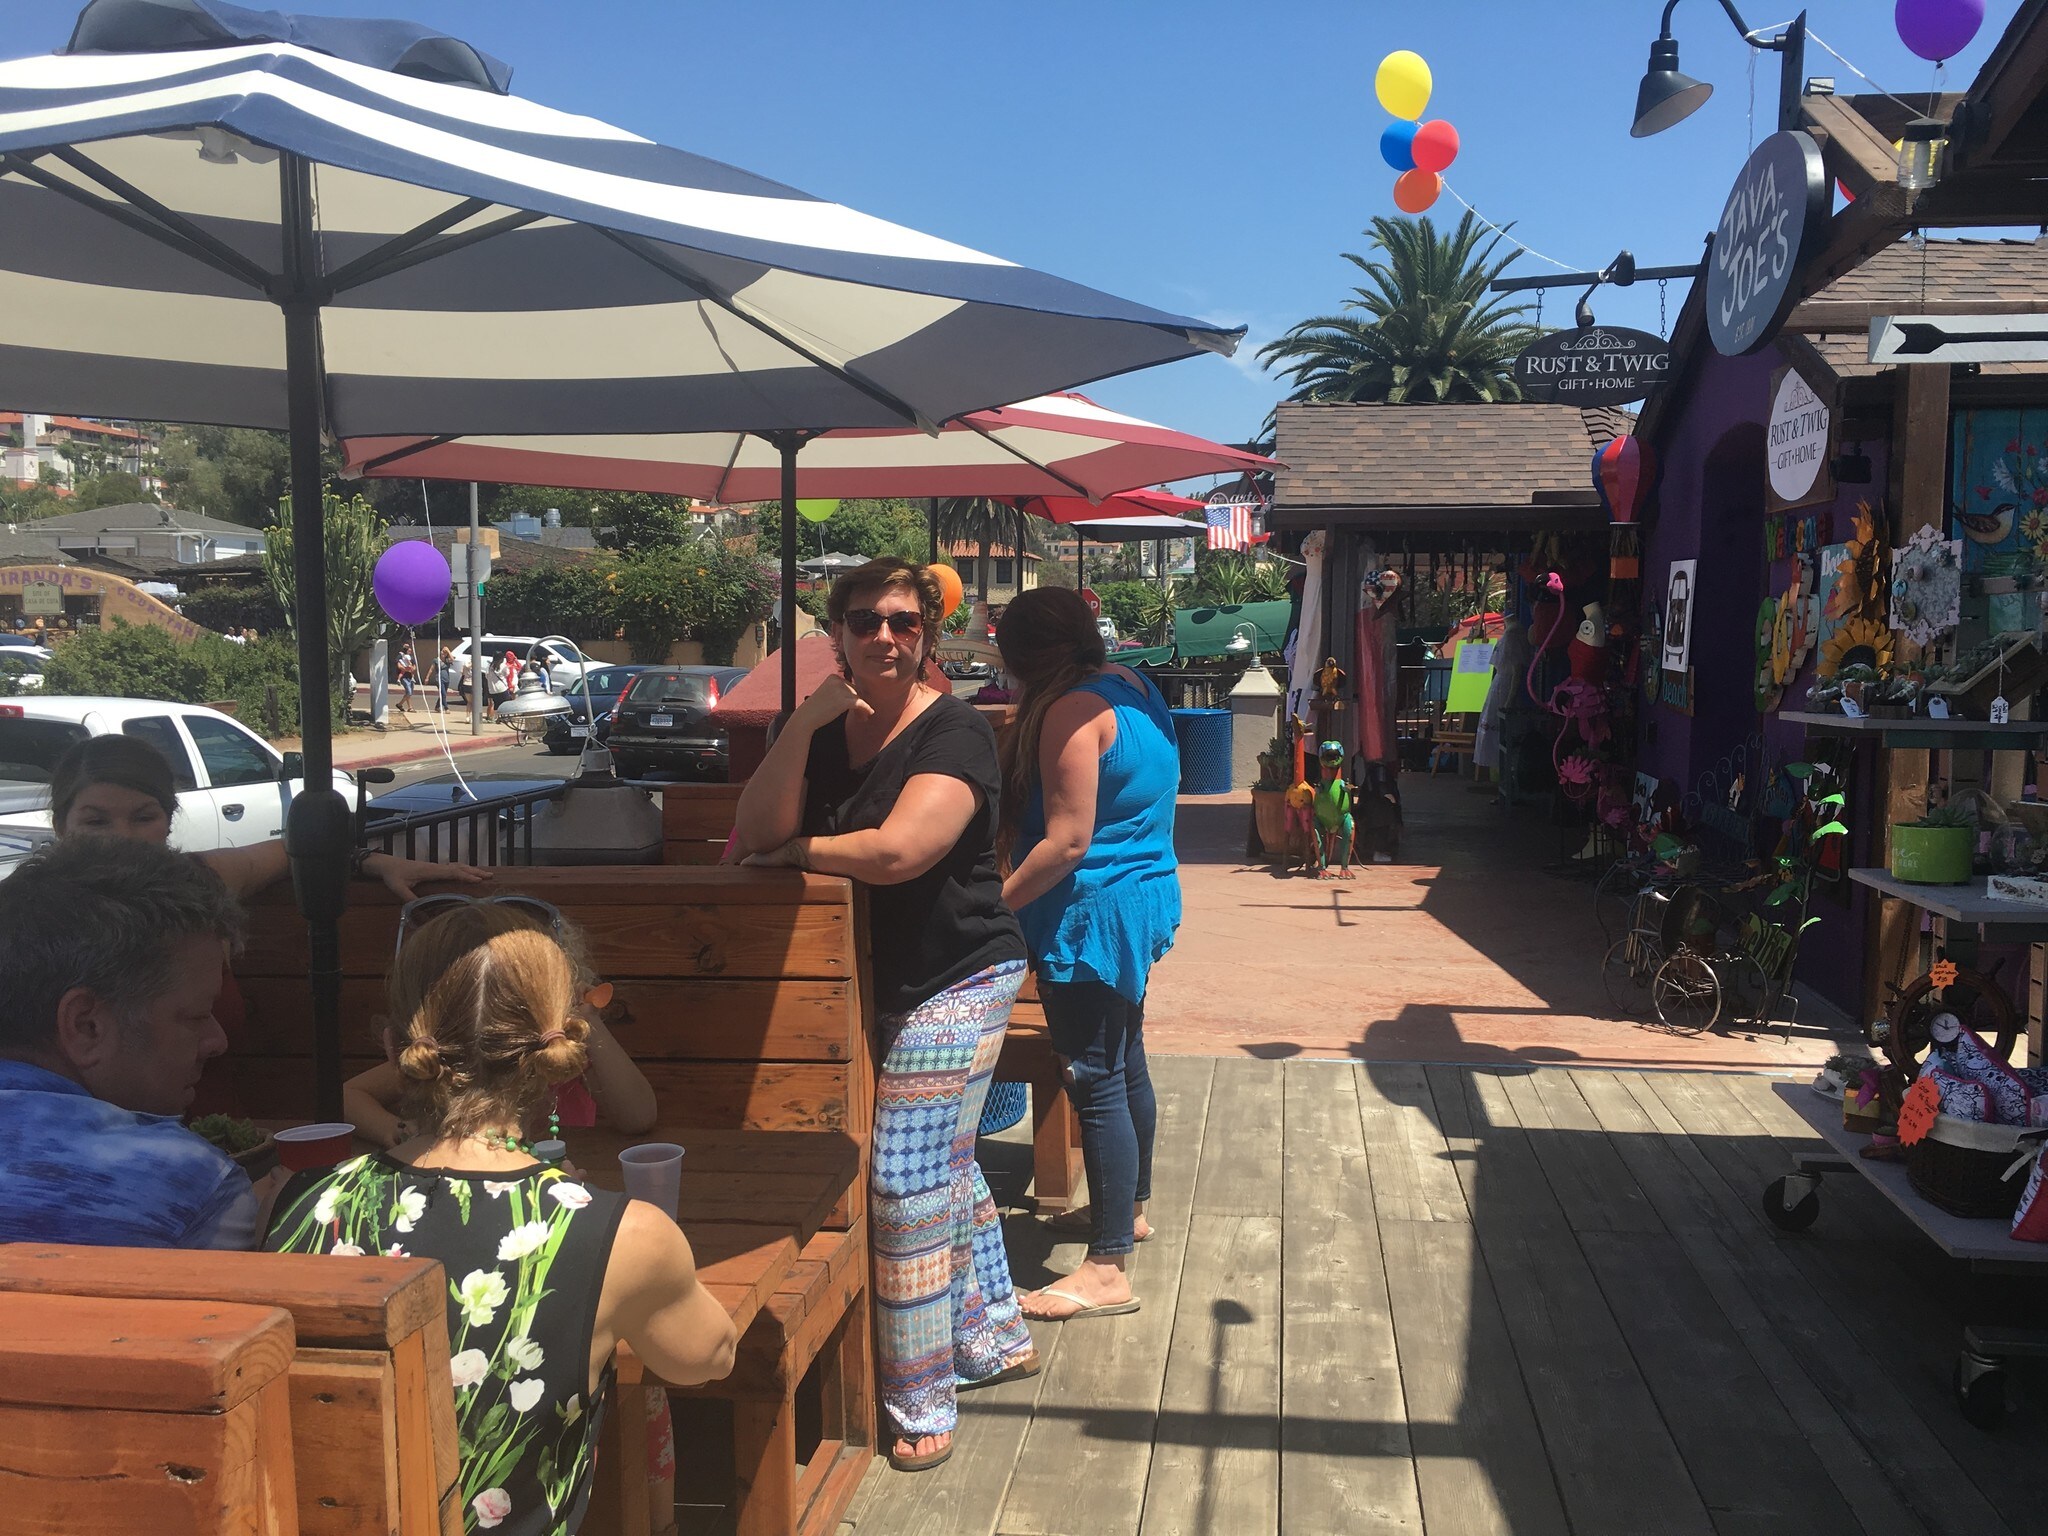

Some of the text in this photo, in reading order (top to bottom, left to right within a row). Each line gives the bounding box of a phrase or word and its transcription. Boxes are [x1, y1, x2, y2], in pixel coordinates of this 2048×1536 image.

[1719, 162, 1776, 270] JAVA
[1722, 192, 1789, 327] JOE'S
[1525, 352, 1671, 375] RUST & TWIG
[1558, 377, 1636, 390] GIFT HOME
[1770, 407, 1828, 447] RUST & TWIG
[1777, 442, 1817, 469] GIFT HOME
